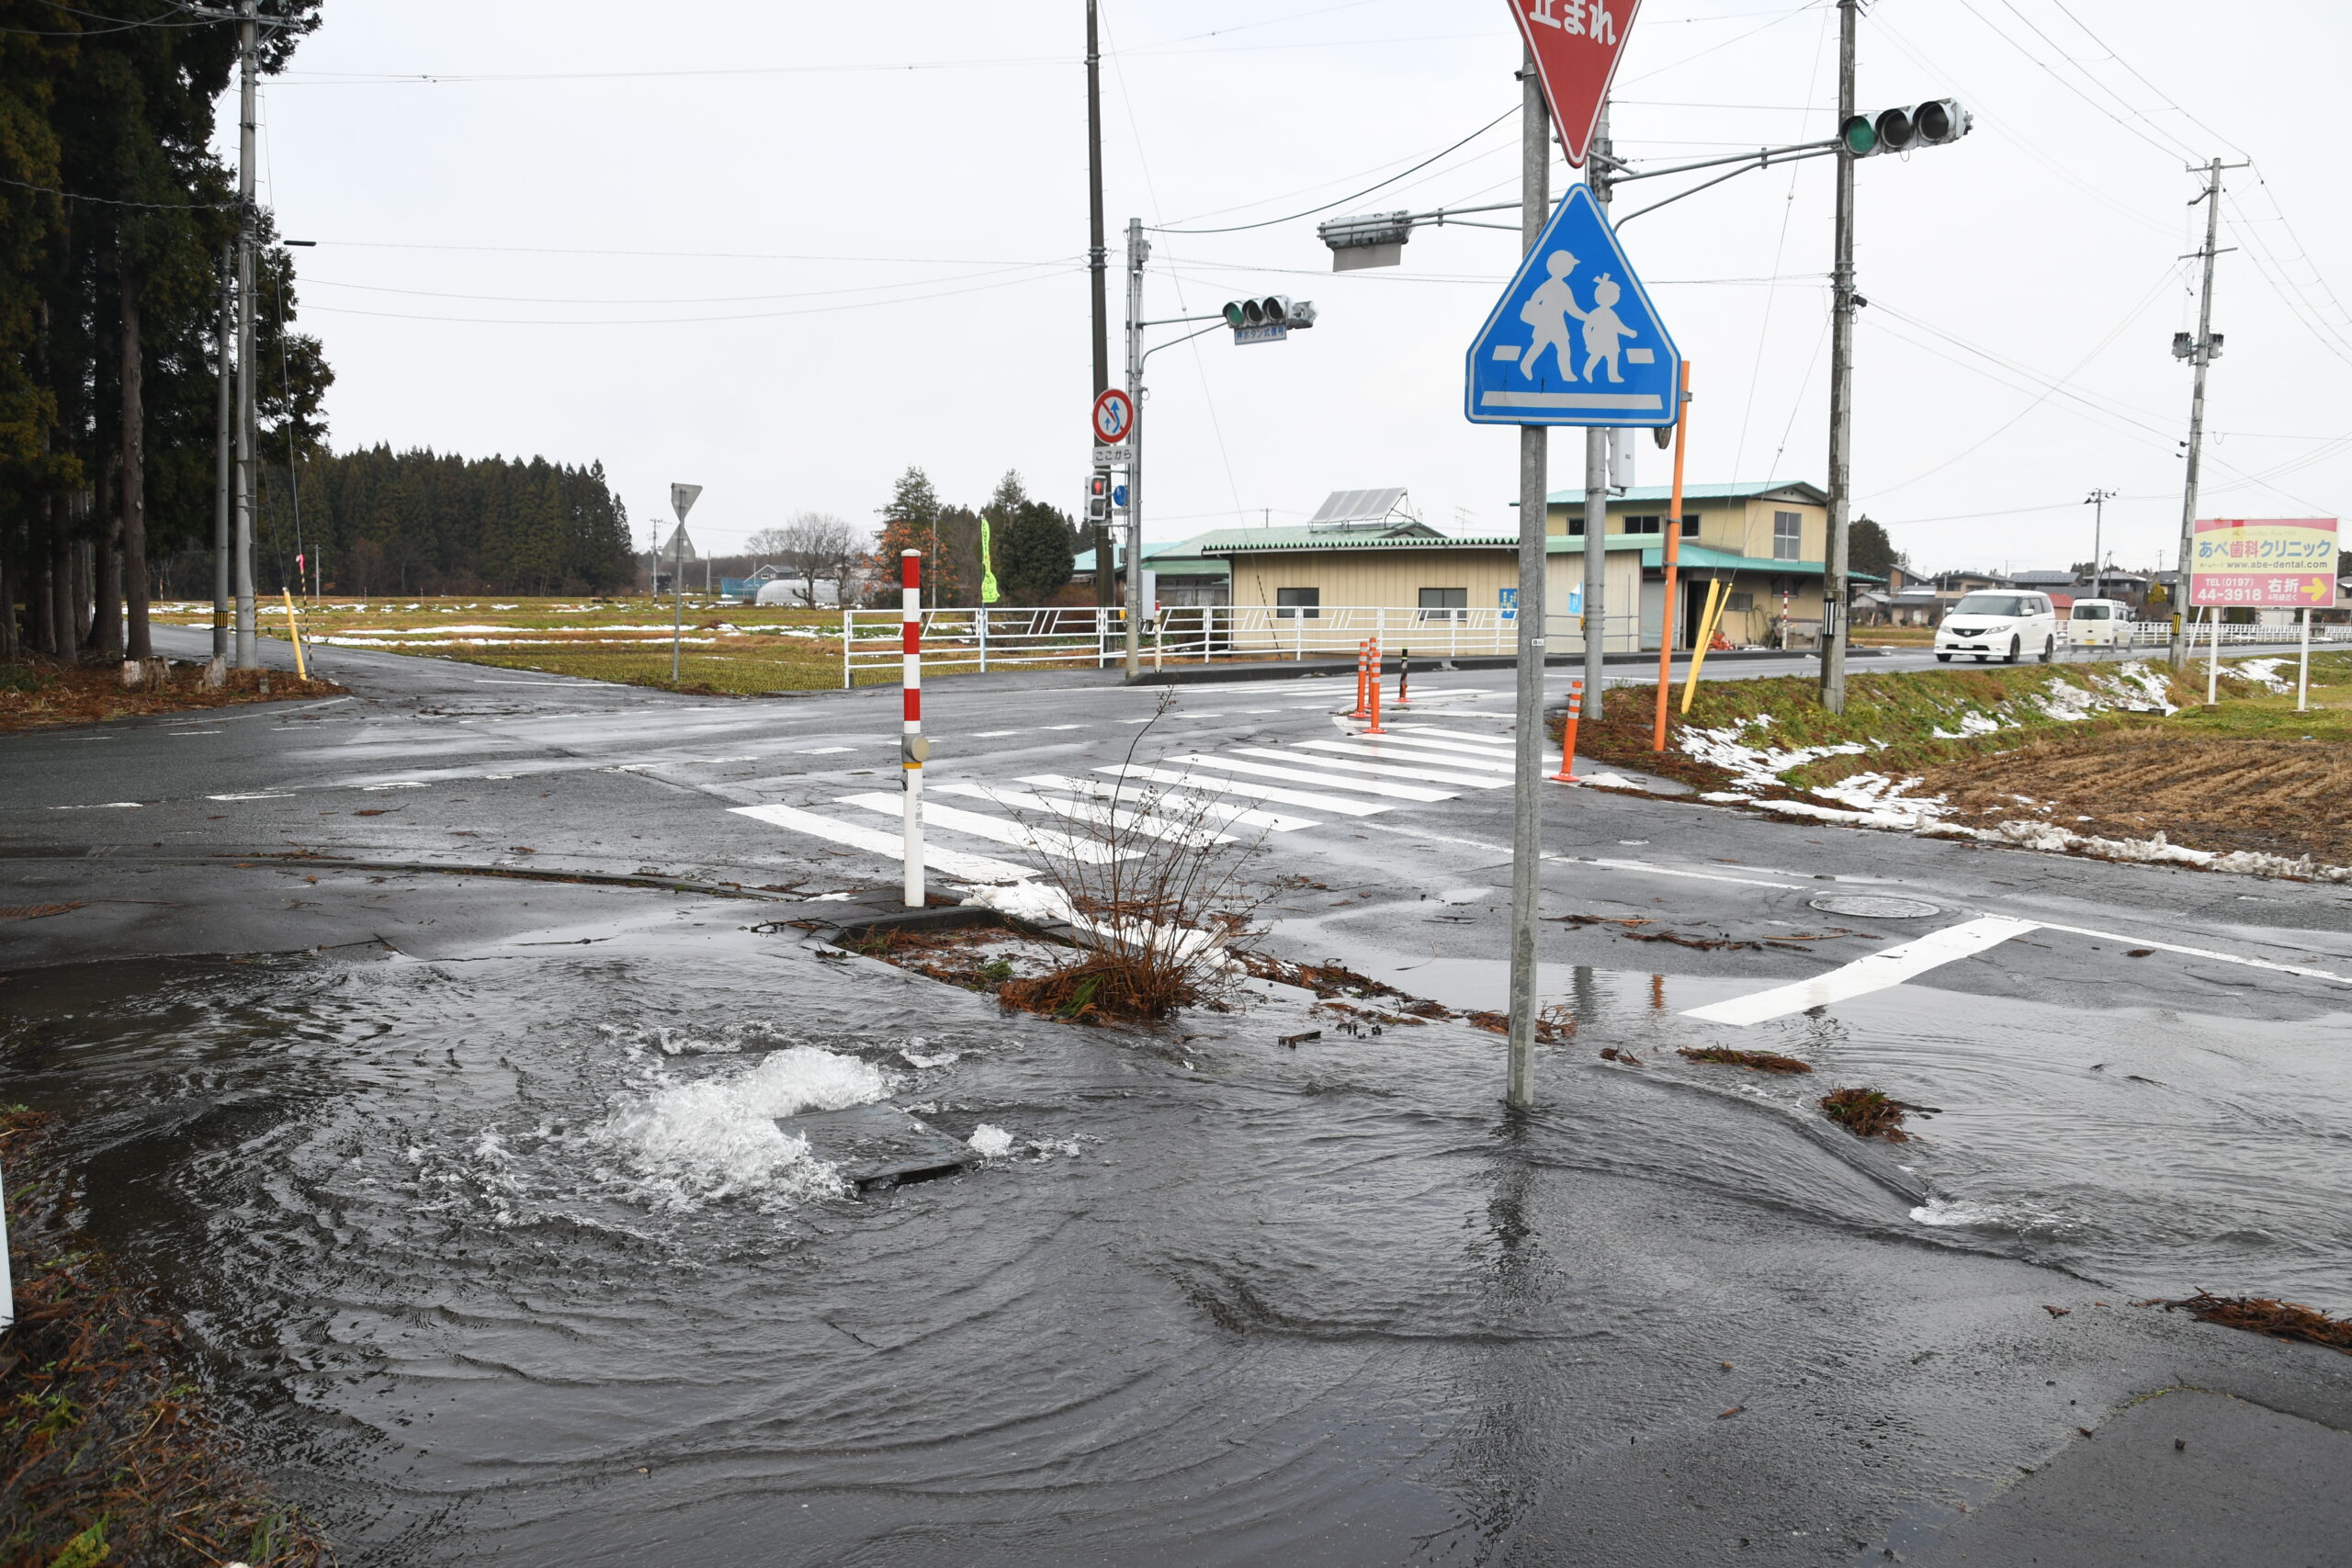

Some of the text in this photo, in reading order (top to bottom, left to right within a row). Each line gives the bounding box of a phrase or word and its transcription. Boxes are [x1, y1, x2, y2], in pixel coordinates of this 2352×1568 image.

[1529, 0, 1617, 46] 止まれ
[1095, 449, 1132, 461] ここから
[2199, 539, 2331, 558] あべ歯科クリニック
[2227, 560, 2327, 569] www.abe-dental.com
[2267, 578, 2299, 593] 右折
[2198, 589, 2262, 602] 44-3918
